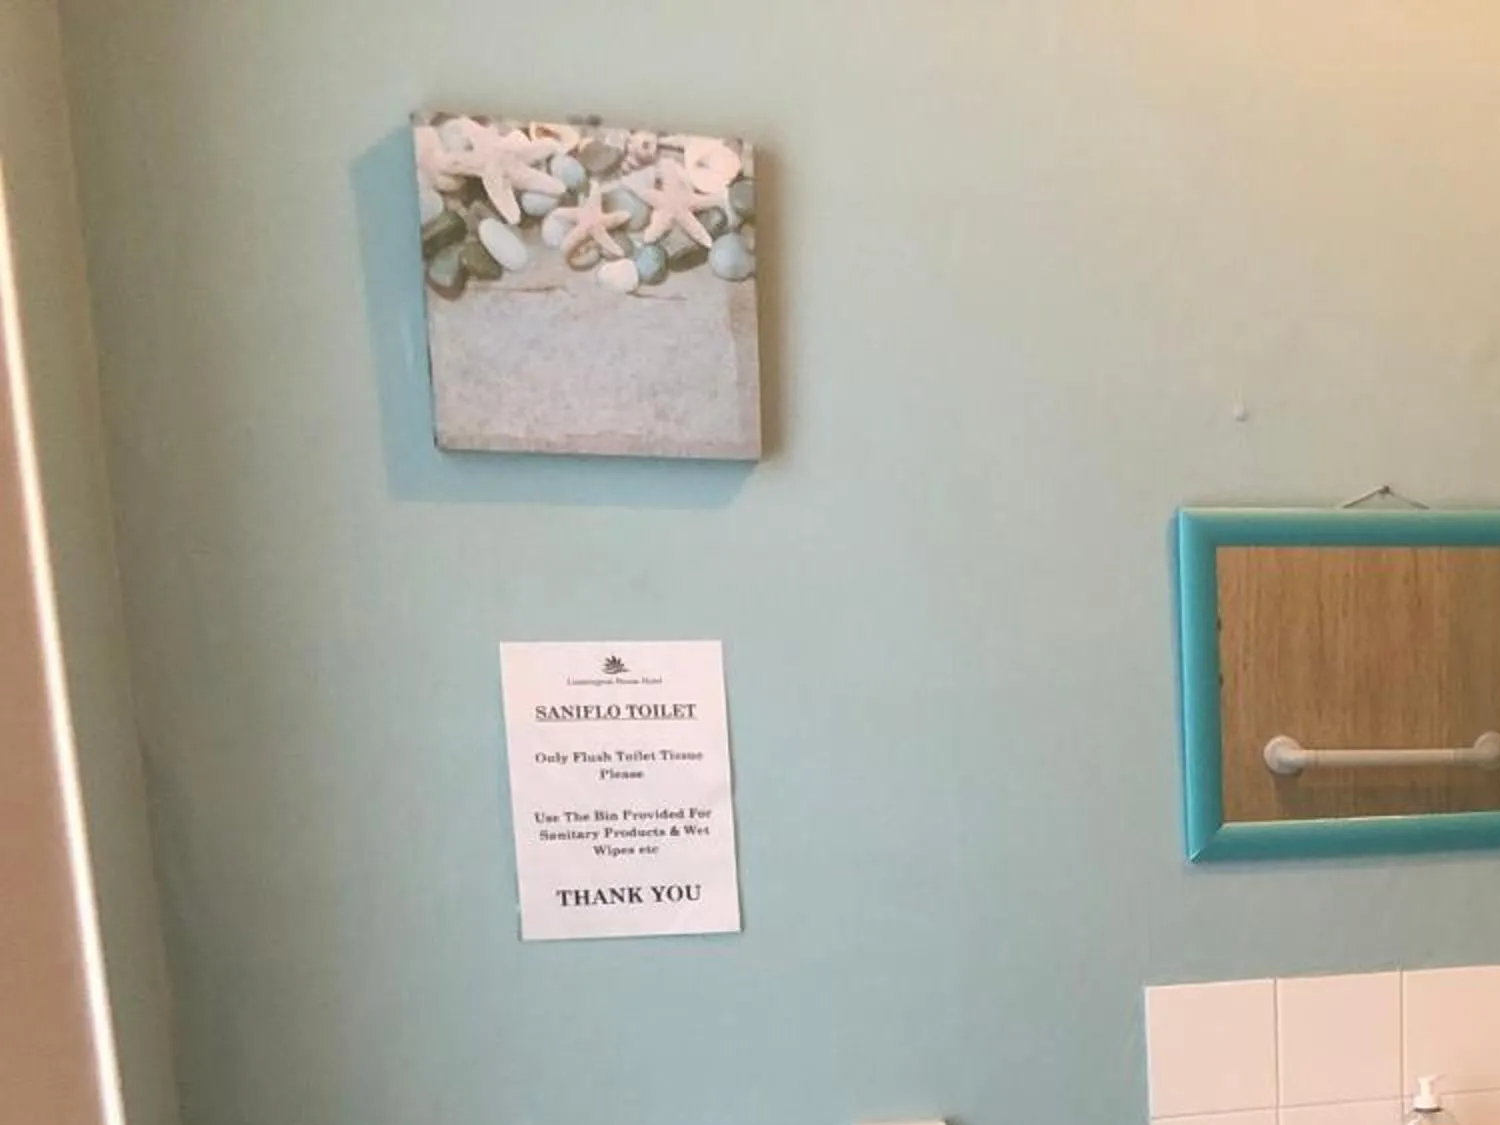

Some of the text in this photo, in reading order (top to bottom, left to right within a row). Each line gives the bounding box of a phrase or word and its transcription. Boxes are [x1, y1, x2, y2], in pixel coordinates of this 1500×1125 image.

[535, 704, 697, 721] SANIFLO TOILET
[535, 750, 703, 764] Only Flush Toilet Tissue
[598, 768, 645, 780] Please
[534, 807, 712, 823] Use The Bin Provided For
[540, 824, 710, 841] Sanitary Products & Wet
[593, 844, 659, 857] Wipes etc
[556, 884, 702, 907] THANK YOU
